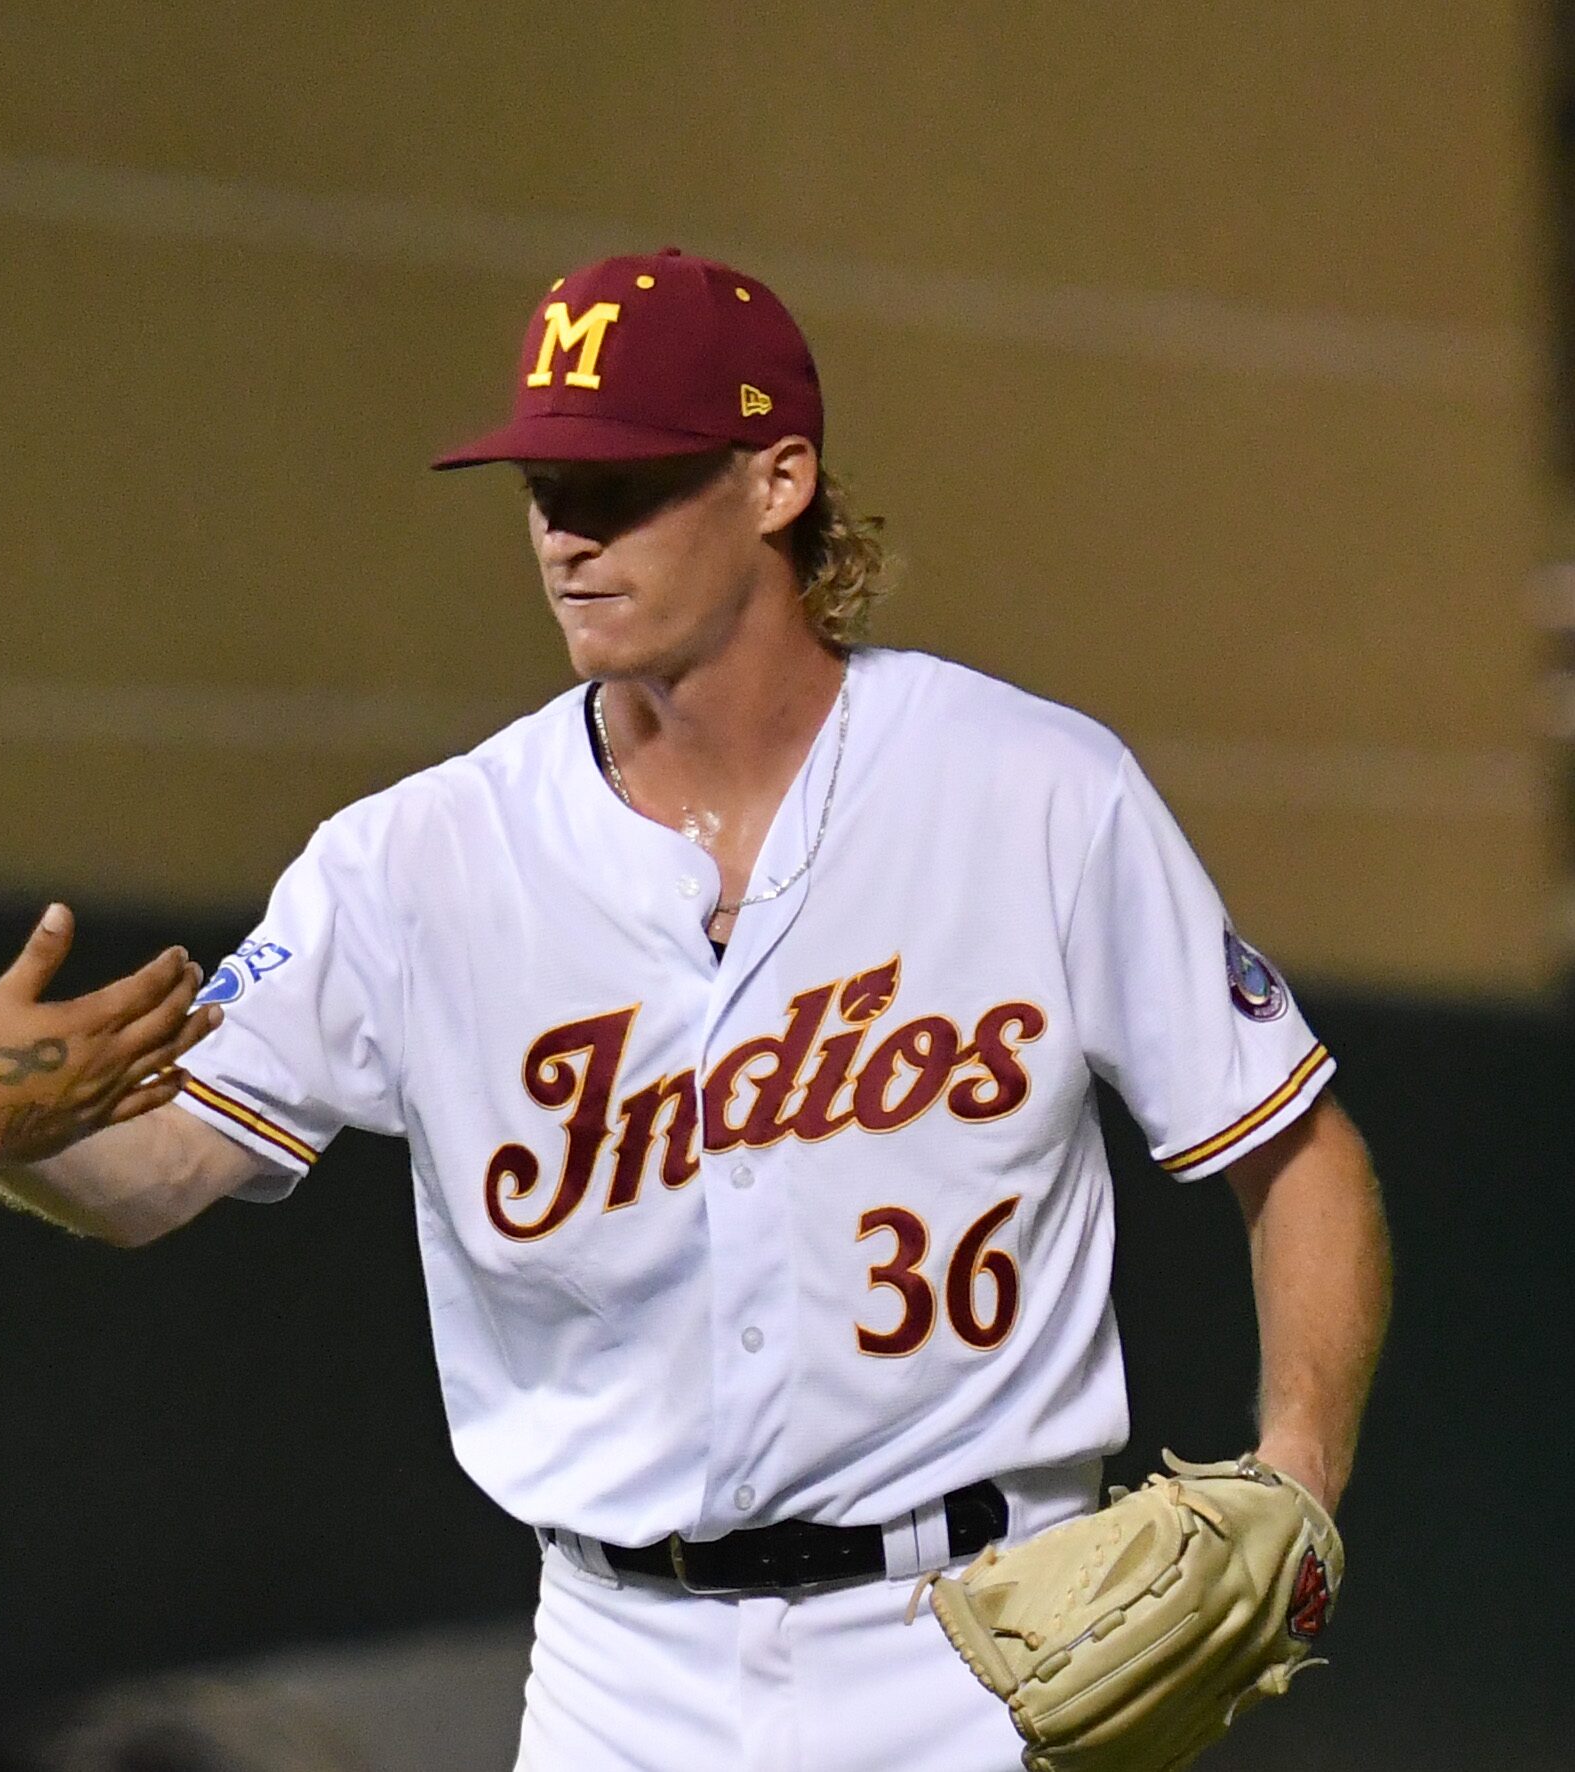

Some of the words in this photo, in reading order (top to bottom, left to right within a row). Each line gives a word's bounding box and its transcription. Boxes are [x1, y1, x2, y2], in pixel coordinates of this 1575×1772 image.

[526, 301, 621, 390] M
[485, 951, 1047, 1243] Indios
[855, 1195, 1021, 1358] 36
